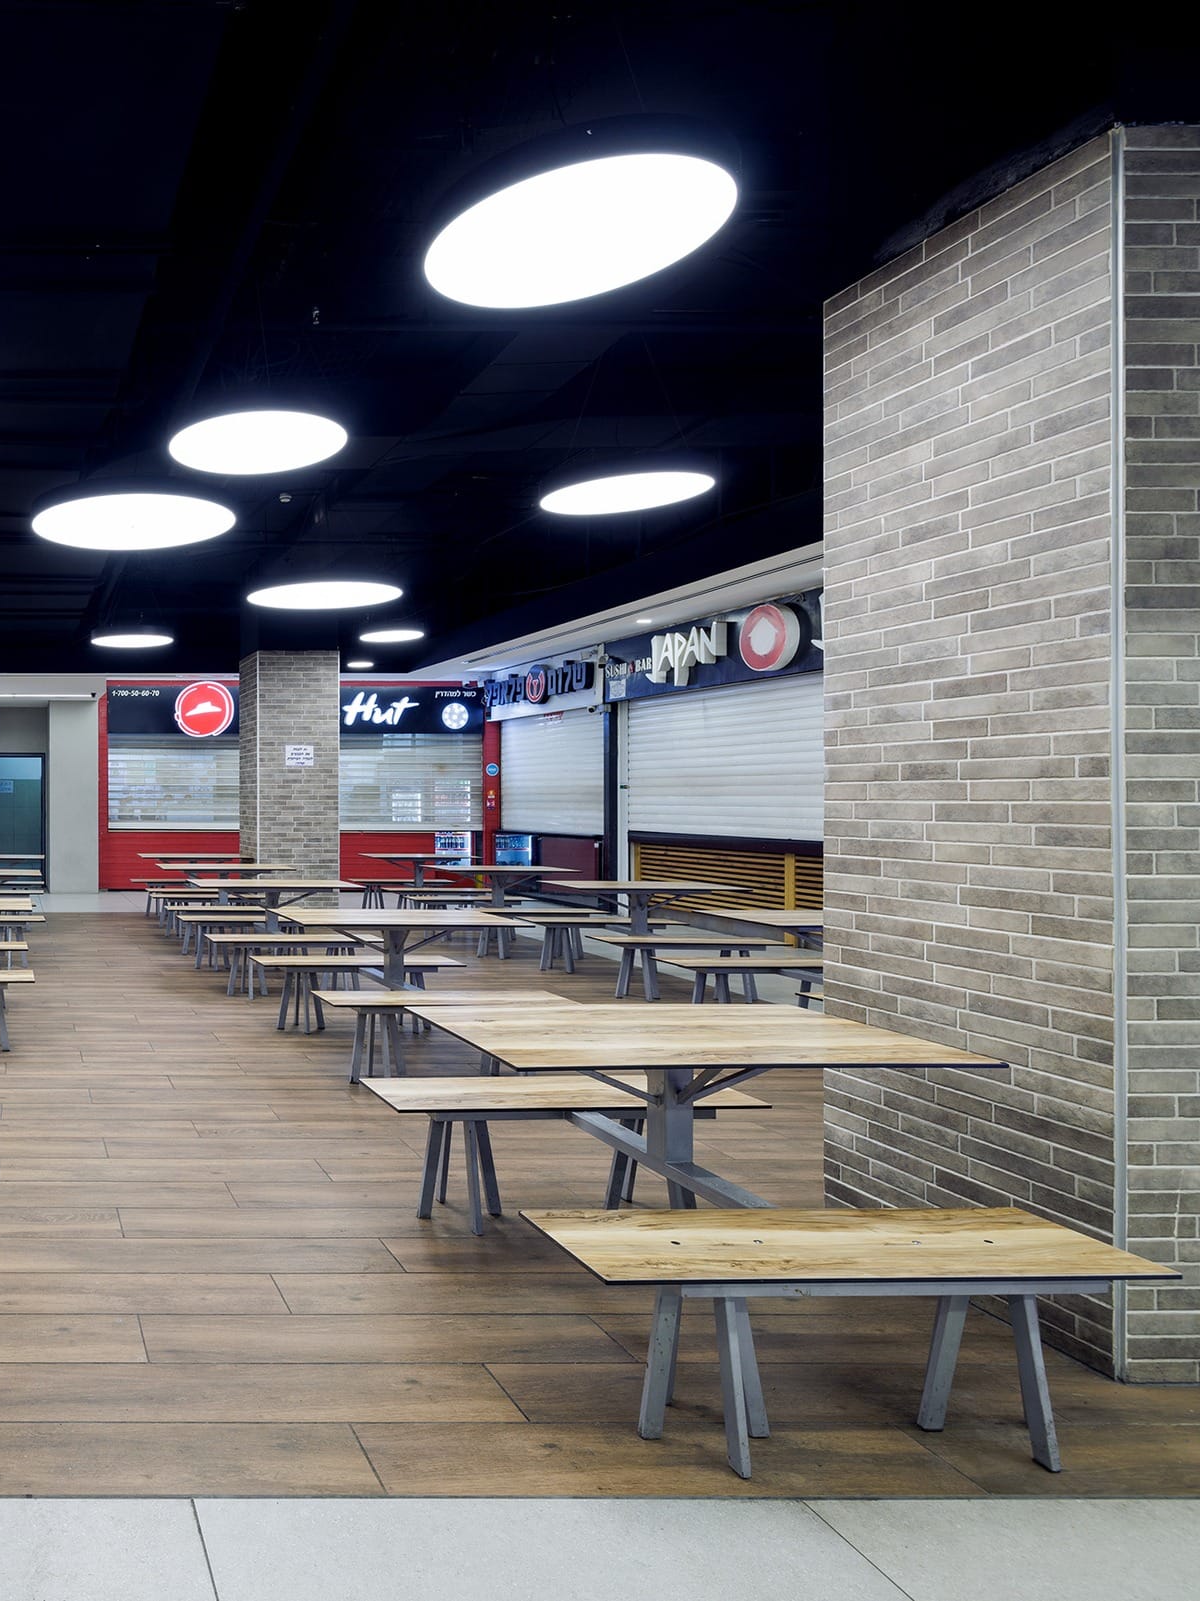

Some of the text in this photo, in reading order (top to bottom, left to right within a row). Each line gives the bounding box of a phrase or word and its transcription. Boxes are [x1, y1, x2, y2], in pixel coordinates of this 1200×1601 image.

[605, 657, 652, 679] SUSHI BAR
[645, 621, 724, 686] JAPAN
[111, 689, 160, 697] 1-700-50-60-70
[434, 689, 477, 699] כשר למהדרין
[484, 674, 526, 706] פלאפל
[547, 661, 589, 695] שלום
[342, 691, 420, 726] Hut
